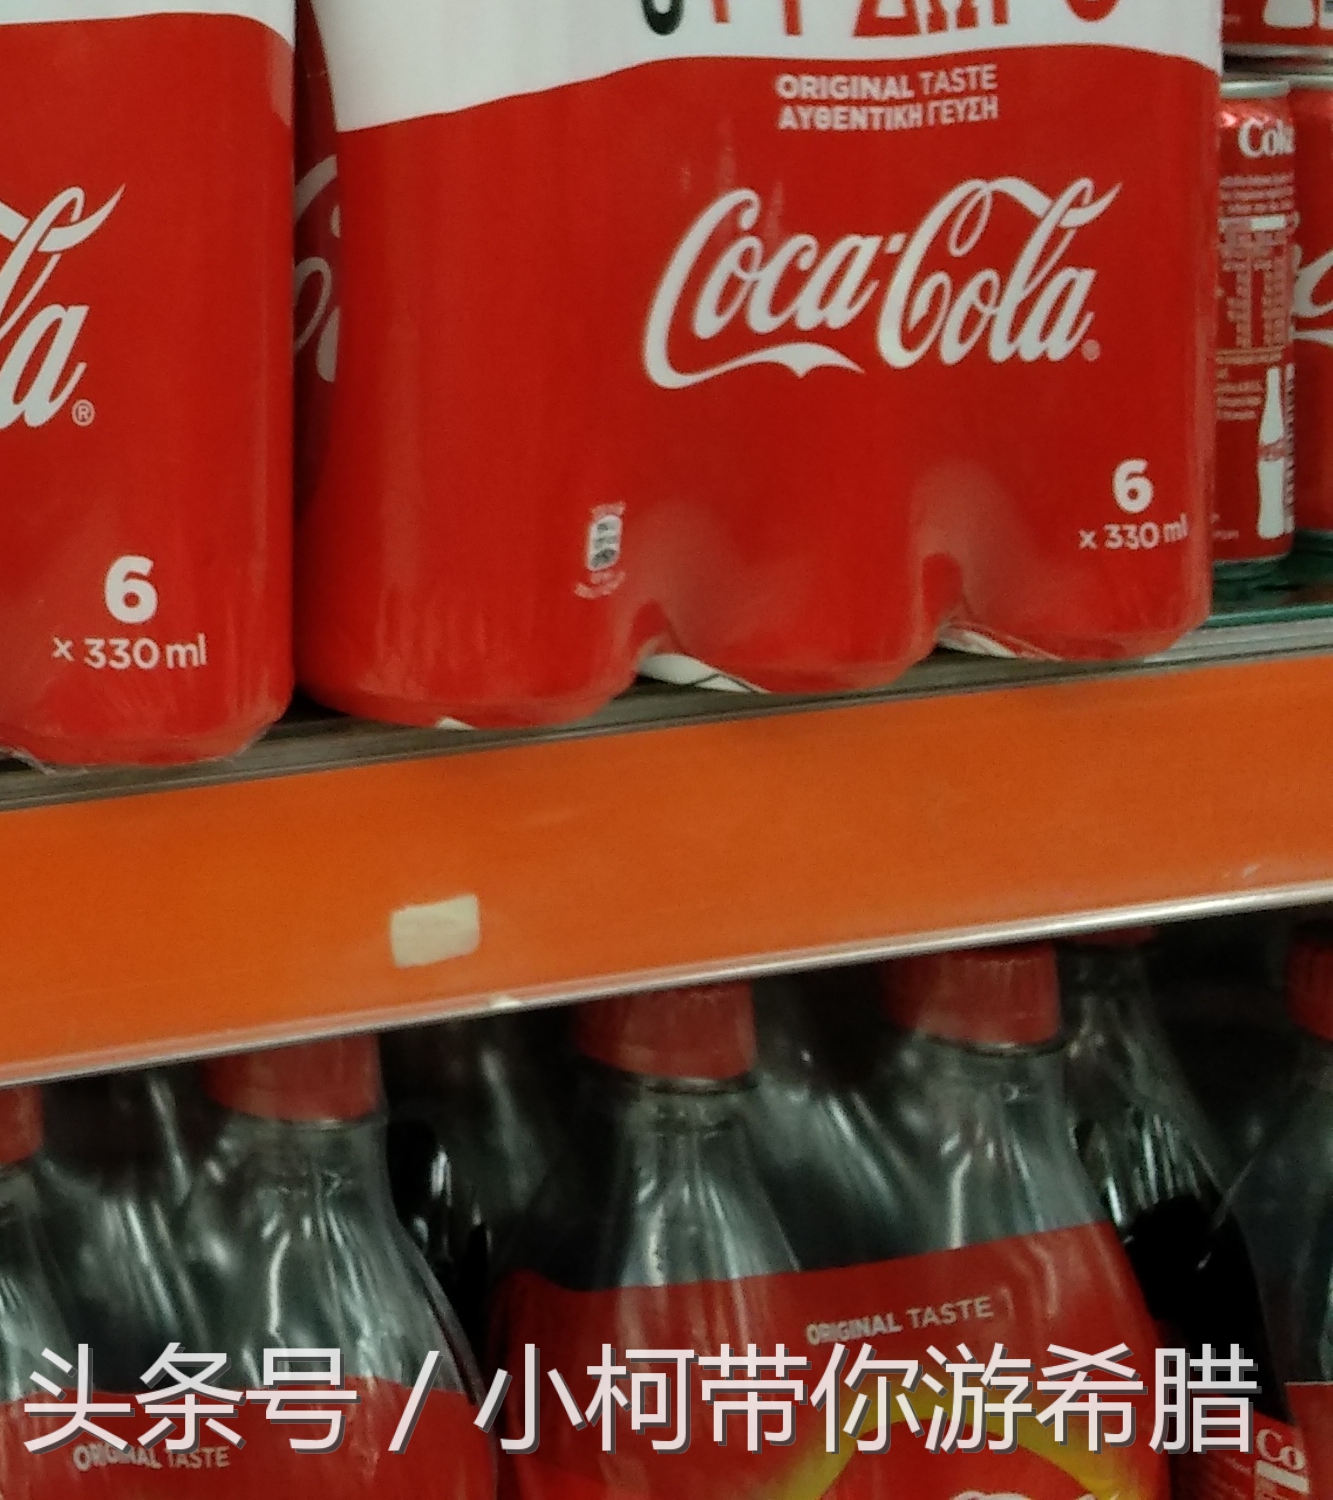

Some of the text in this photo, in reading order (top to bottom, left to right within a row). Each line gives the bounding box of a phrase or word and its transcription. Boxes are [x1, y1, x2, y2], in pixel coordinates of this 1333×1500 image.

[776, 64, 999, 101] ORIGINAL TASTE
[643, 176, 1122, 390] Coca-Cola
[1113, 458, 1154, 514] 6
[105, 555, 158, 623] 6
